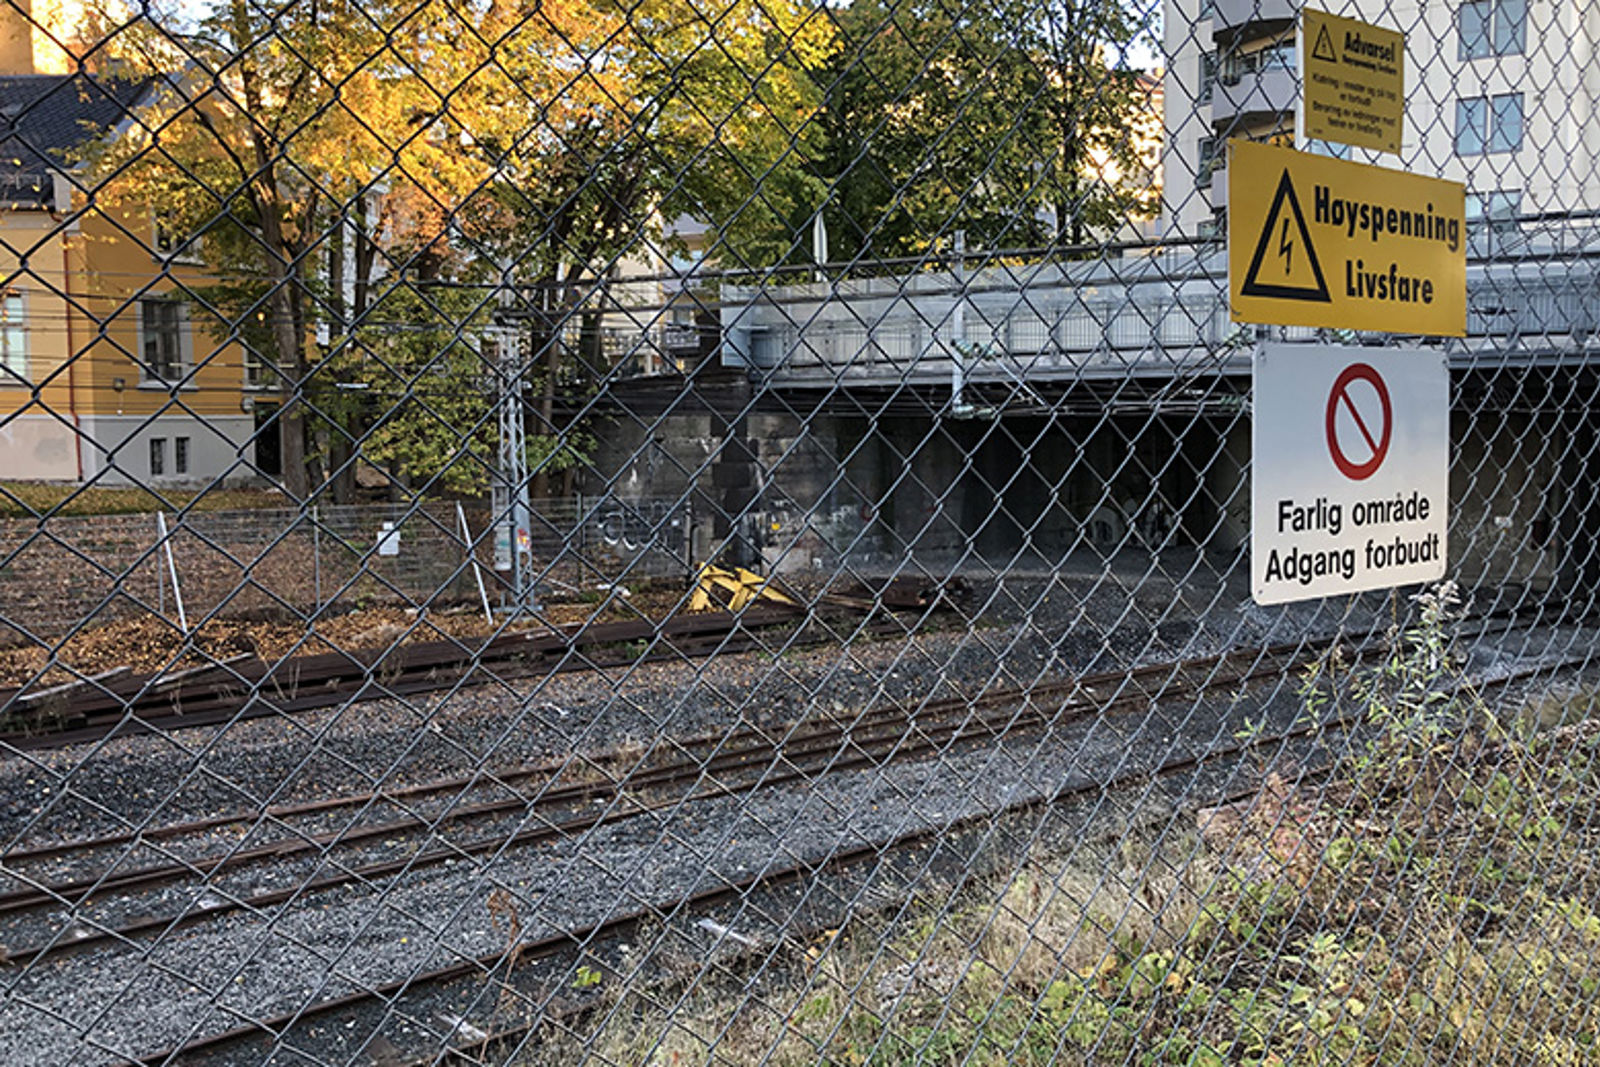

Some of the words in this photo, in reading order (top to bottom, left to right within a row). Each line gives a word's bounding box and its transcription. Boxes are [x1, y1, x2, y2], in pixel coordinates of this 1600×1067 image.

[1344, 31, 1395, 62] Advarsel
[1315, 185, 1459, 253] Høyspenning
[1346, 260, 1433, 304] Livsfare
[1278, 498, 1342, 535] Farlig
[1352, 491, 1429, 526] område
[1265, 548, 1355, 586] Adgang
[1366, 533, 1440, 569] forbudt
